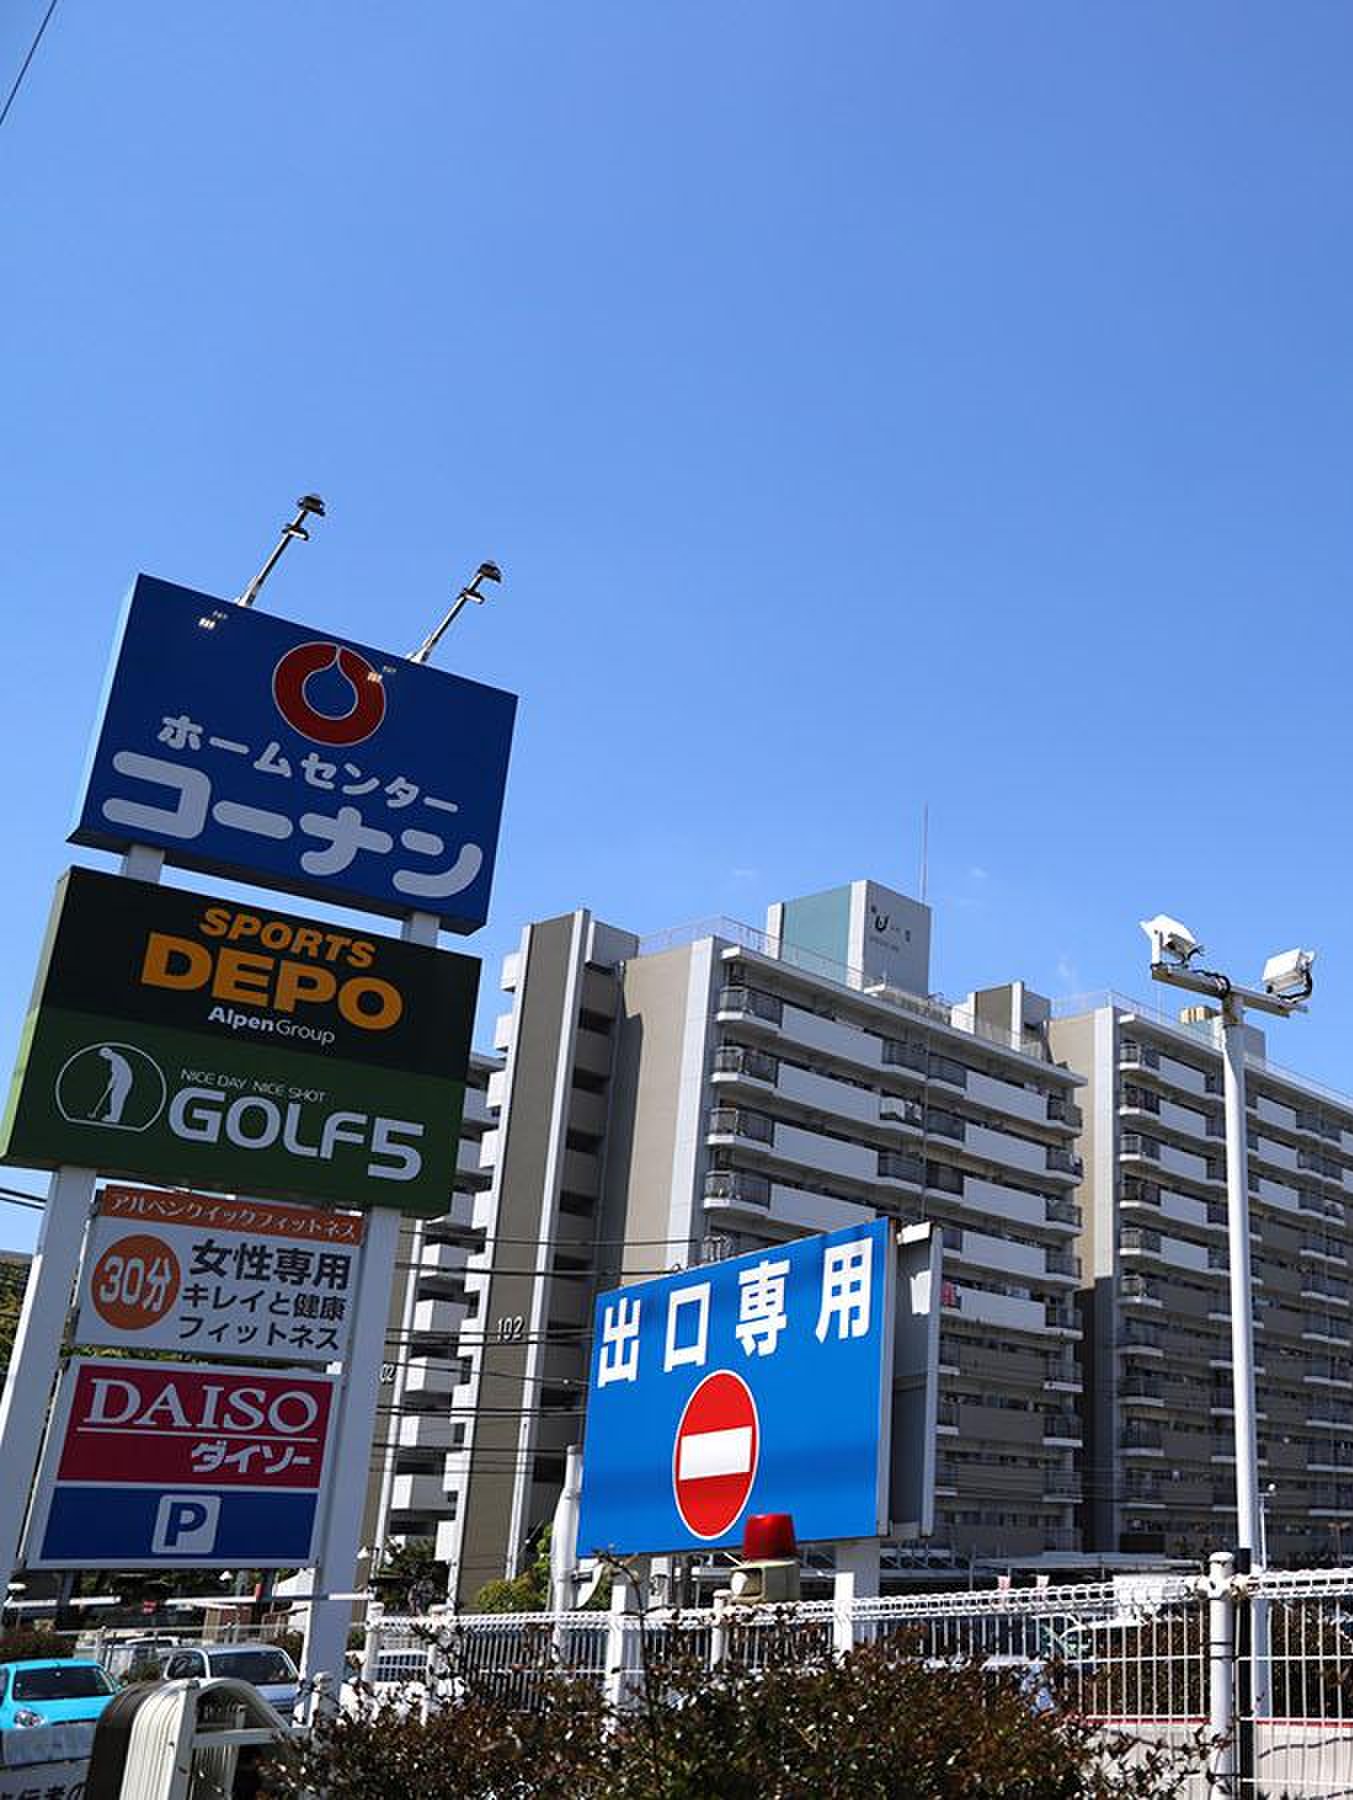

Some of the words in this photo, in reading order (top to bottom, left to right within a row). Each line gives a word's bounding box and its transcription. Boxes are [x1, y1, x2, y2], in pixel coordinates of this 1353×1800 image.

[157, 714, 459, 813] ホームセンター
[102, 751, 483, 897] コーナン
[200, 906, 377, 968] SPORTS
[141, 932, 403, 1031] DEPO
[180, 1068, 216, 1085] NICE
[253, 1080, 287, 1097] NICE
[288, 1087, 328, 1103] SHOT
[168, 1087, 425, 1181] GOLF5
[100, 1254, 172, 1313] 30分
[189, 1238, 352, 1291] 女性専用
[181, 1282, 347, 1322] キレイと健康
[497, 1315, 524, 1341] 102
[597, 1237, 874, 1388] 出口専用
[178, 1315, 340, 1351] フィットネス
[83, 1379, 318, 1434] DAISO
[190, 1440, 313, 1474] ダイソー
[163, 1501, 207, 1546] P
